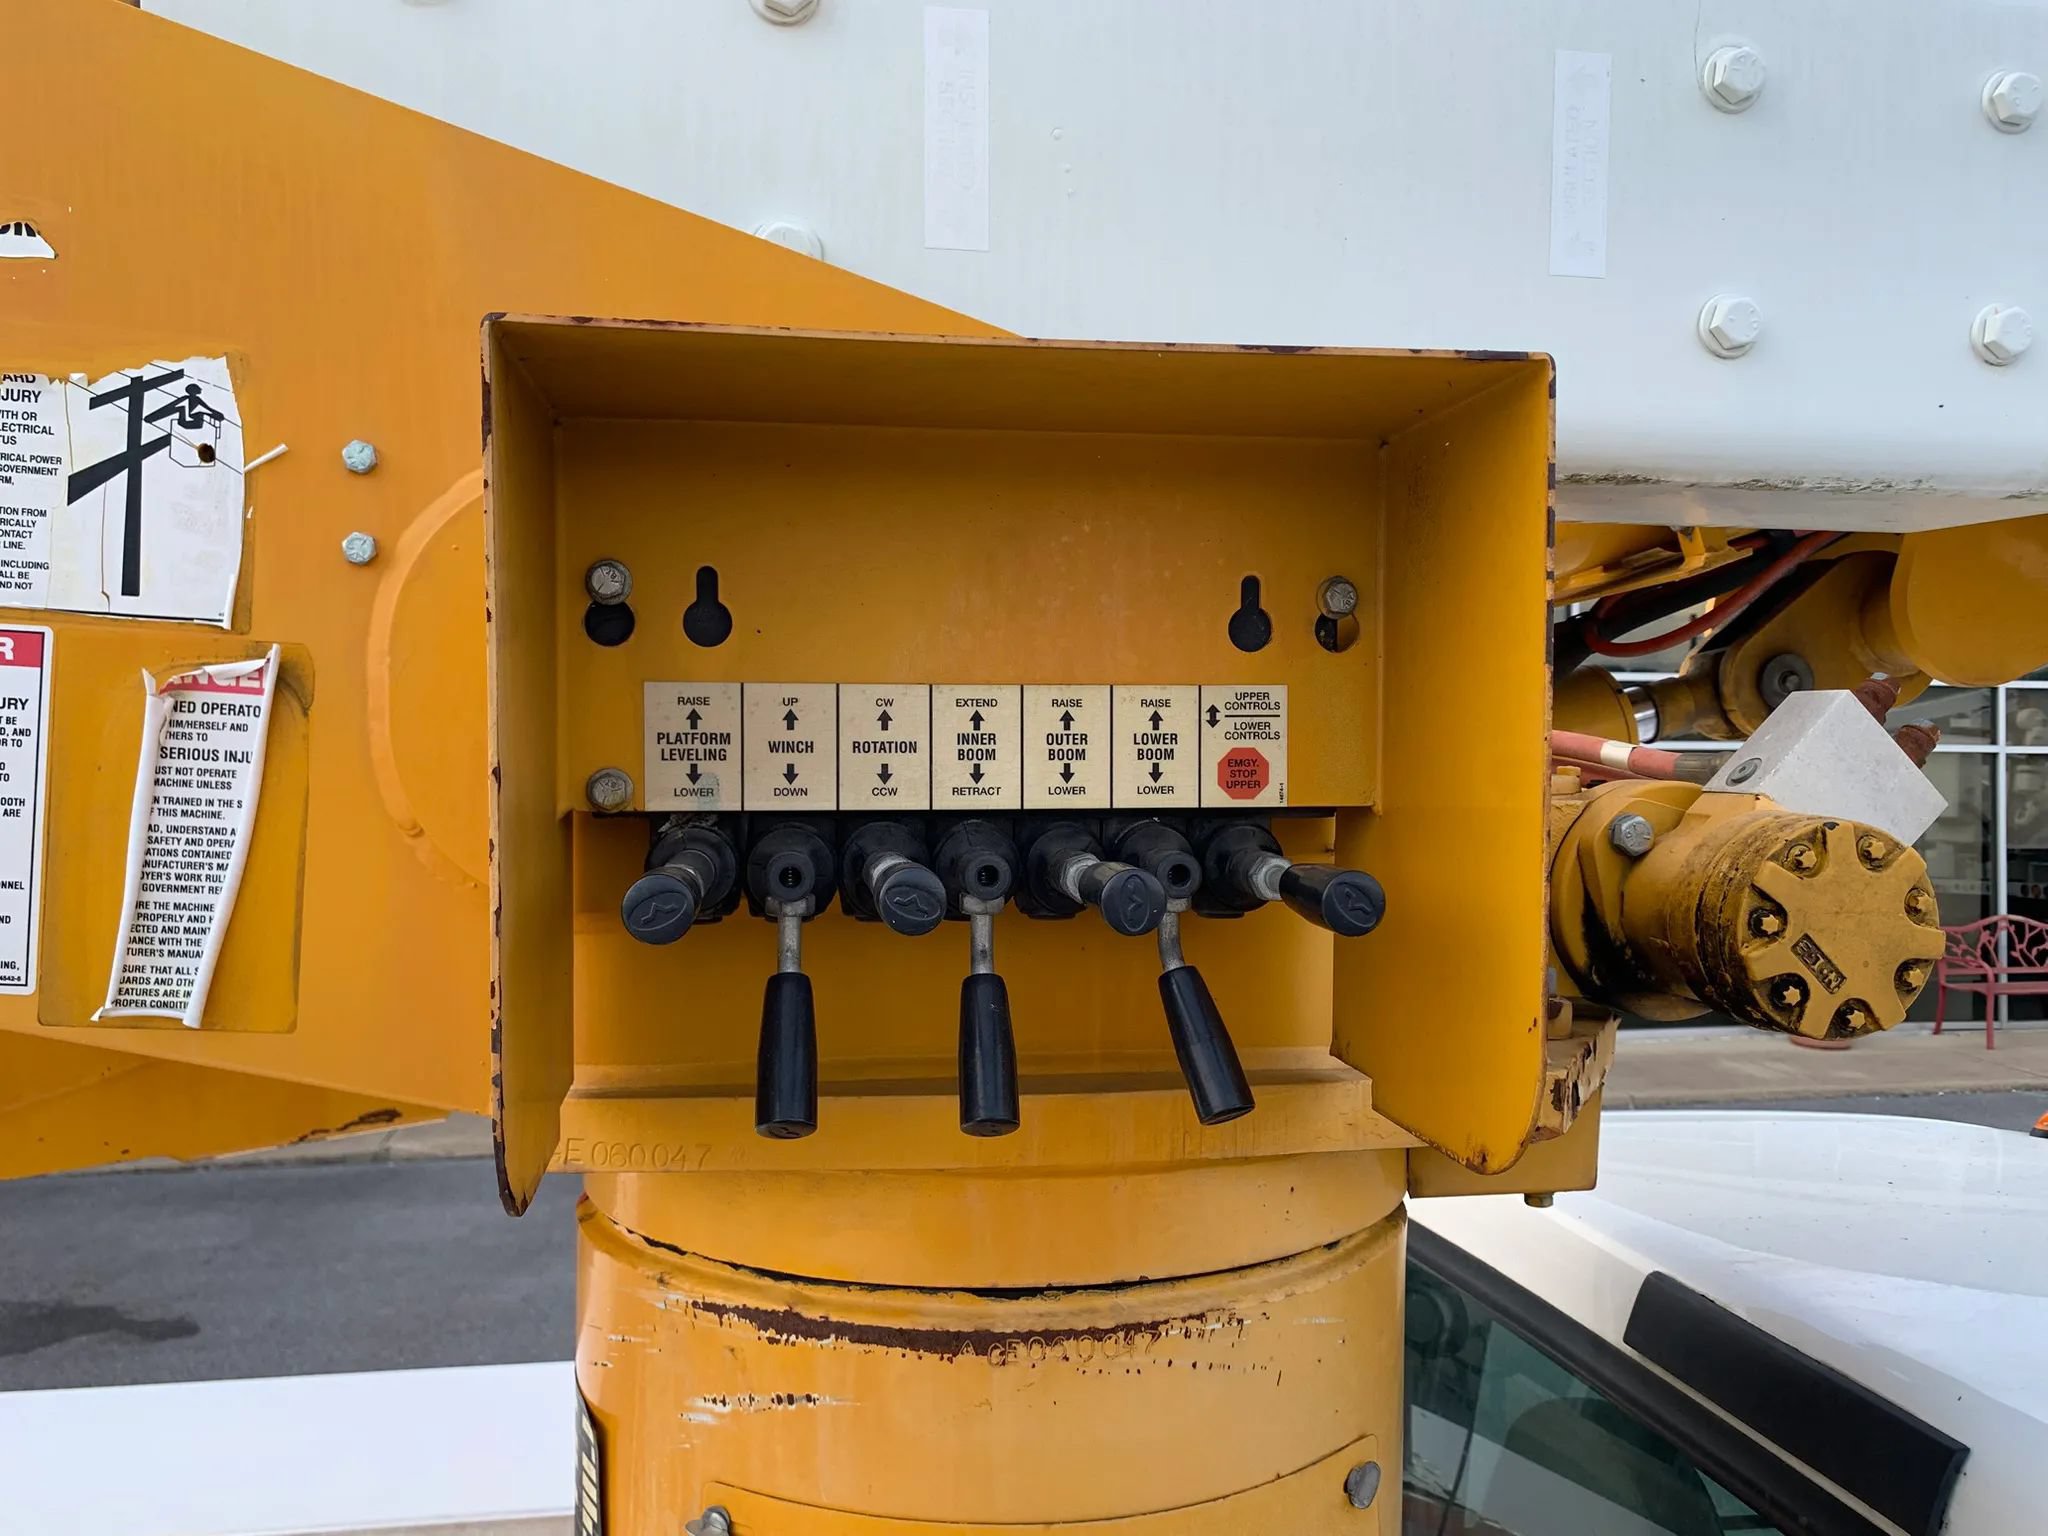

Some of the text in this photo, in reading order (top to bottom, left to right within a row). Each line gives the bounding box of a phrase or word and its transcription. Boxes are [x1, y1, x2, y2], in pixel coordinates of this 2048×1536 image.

[0, 409, 38, 421] ITH OR
[0, 452, 62, 465] RICAL POWER
[21, 508, 47, 517] FROM
[3, 541, 26, 550] LINE.
[1, 559, 50, 570] INCLUDING
[17, 571, 30, 580] BE
[14, 582, 33, 590] NOT
[677, 696, 710, 706] RAISE
[783, 697, 799, 706] UP
[1235, 692, 1270, 701] UPPER
[875, 698, 894, 707] CW
[955, 698, 998, 707] EXTEND
[1051, 699, 1083, 708] RAISE
[1140, 699, 1171, 708] RAISE
[1224, 701, 1281, 711] CONTROLS
[201, 702, 261, 718] OPERATO
[5, 716, 17, 725] BE
[230, 722, 248, 732] AND
[1234, 722, 1271, 731] LOWER
[12, 728, 31, 737] AND
[196, 732, 208, 742] TO
[1224, 731, 1281, 740] CONTROLS
[10, 738, 23, 748] TO
[657, 732, 731, 745] PLATFORM
[957, 733, 996, 746] INNER
[1046, 733, 1088, 745] OUTER
[1133, 733, 1178, 745] LOWER
[768, 741, 814, 754] WINCH
[852, 741, 918, 754] ROTATION
[160, 746, 220, 761] SERIOUS
[661, 748, 727, 761] LEVELING
[957, 748, 996, 761] BOOM
[1048, 748, 1086, 761] BOOM
[1137, 748, 1175, 761] BOOM
[1227, 759, 1260, 768] EMGY.
[175, 767, 194, 776] NOT
[196, 767, 237, 779] OPERATE
[1229, 769, 1257, 778] STOP
[196, 779, 232, 790] UNLESS
[1226, 780, 1261, 789] UPPER
[674, 787, 714, 797] LOWER
[774, 787, 808, 797] DOWN
[871, 787, 898, 796] CCW
[952, 787, 1002, 796] RETRACT
[1048, 786, 1086, 795] LOWER
[1137, 786, 1175, 795] LOWER
[163, 796, 202, 807] TRAINED
[205, 797, 215, 807] IN
[217, 798, 234, 808] THE
[2, 808, 21, 817] ARE
[157, 807, 178, 817] THIS
[180, 809, 226, 820] MACHINE.
[166, 824, 228, 836] UNDERSTAND
[147, 835, 182, 846] SAFETY
[184, 837, 204, 847] AND
[145, 847, 233, 860] ATIONS CONTAINED
[142, 859, 214, 871] NUFACTURER'S
[174, 872, 203, 883] WORK
[141, 882, 206, 894] GOVERNMENT
[153, 901, 171, 911] THE
[173, 902, 215, 912] MACHINE
[137, 912, 185, 923] PROPERLY
[186, 914, 206, 924] AND
[130, 923, 159, 934] ECTED
[160, 925, 181, 935] AND
[158, 937, 183, 946] WITH
[185, 938, 202, 947] THE
[122, 964, 147, 974] SURE
[150, 965, 173, 975] THAT
[175, 966, 192, 975] ALL
[153, 977, 174, 987] AND
[118, 987, 160, 998] EATURES
[162, 989, 181, 998] ARE
[111, 999, 147, 1008] ROPER
